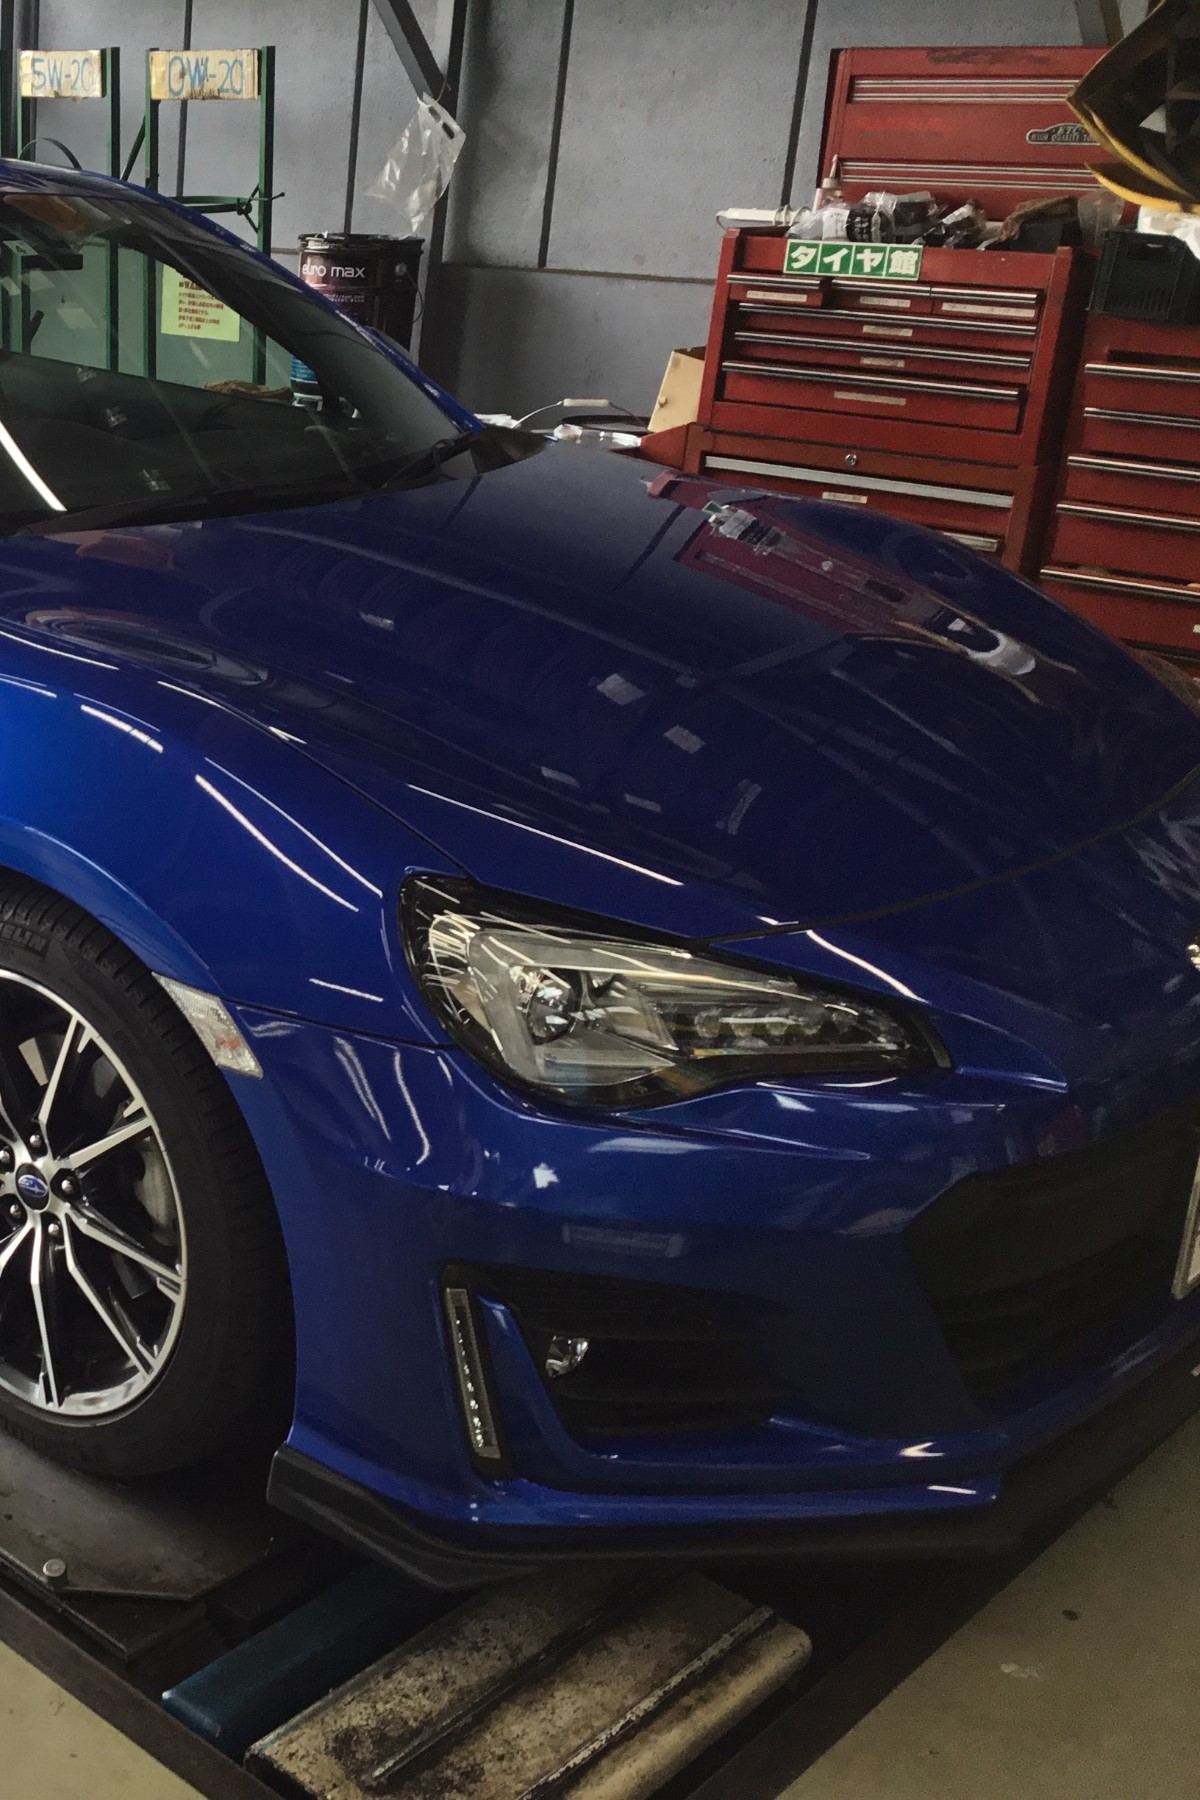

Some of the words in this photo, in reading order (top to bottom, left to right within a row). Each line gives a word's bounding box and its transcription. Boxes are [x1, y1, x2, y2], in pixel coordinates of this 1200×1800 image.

[32, 57, 93, 91] 5W-20
[168, 55, 244, 96] 0W-20
[302, 263, 327, 277] euro
[330, 266, 366, 279] max
[790, 245, 920, 276] タイヤ館
